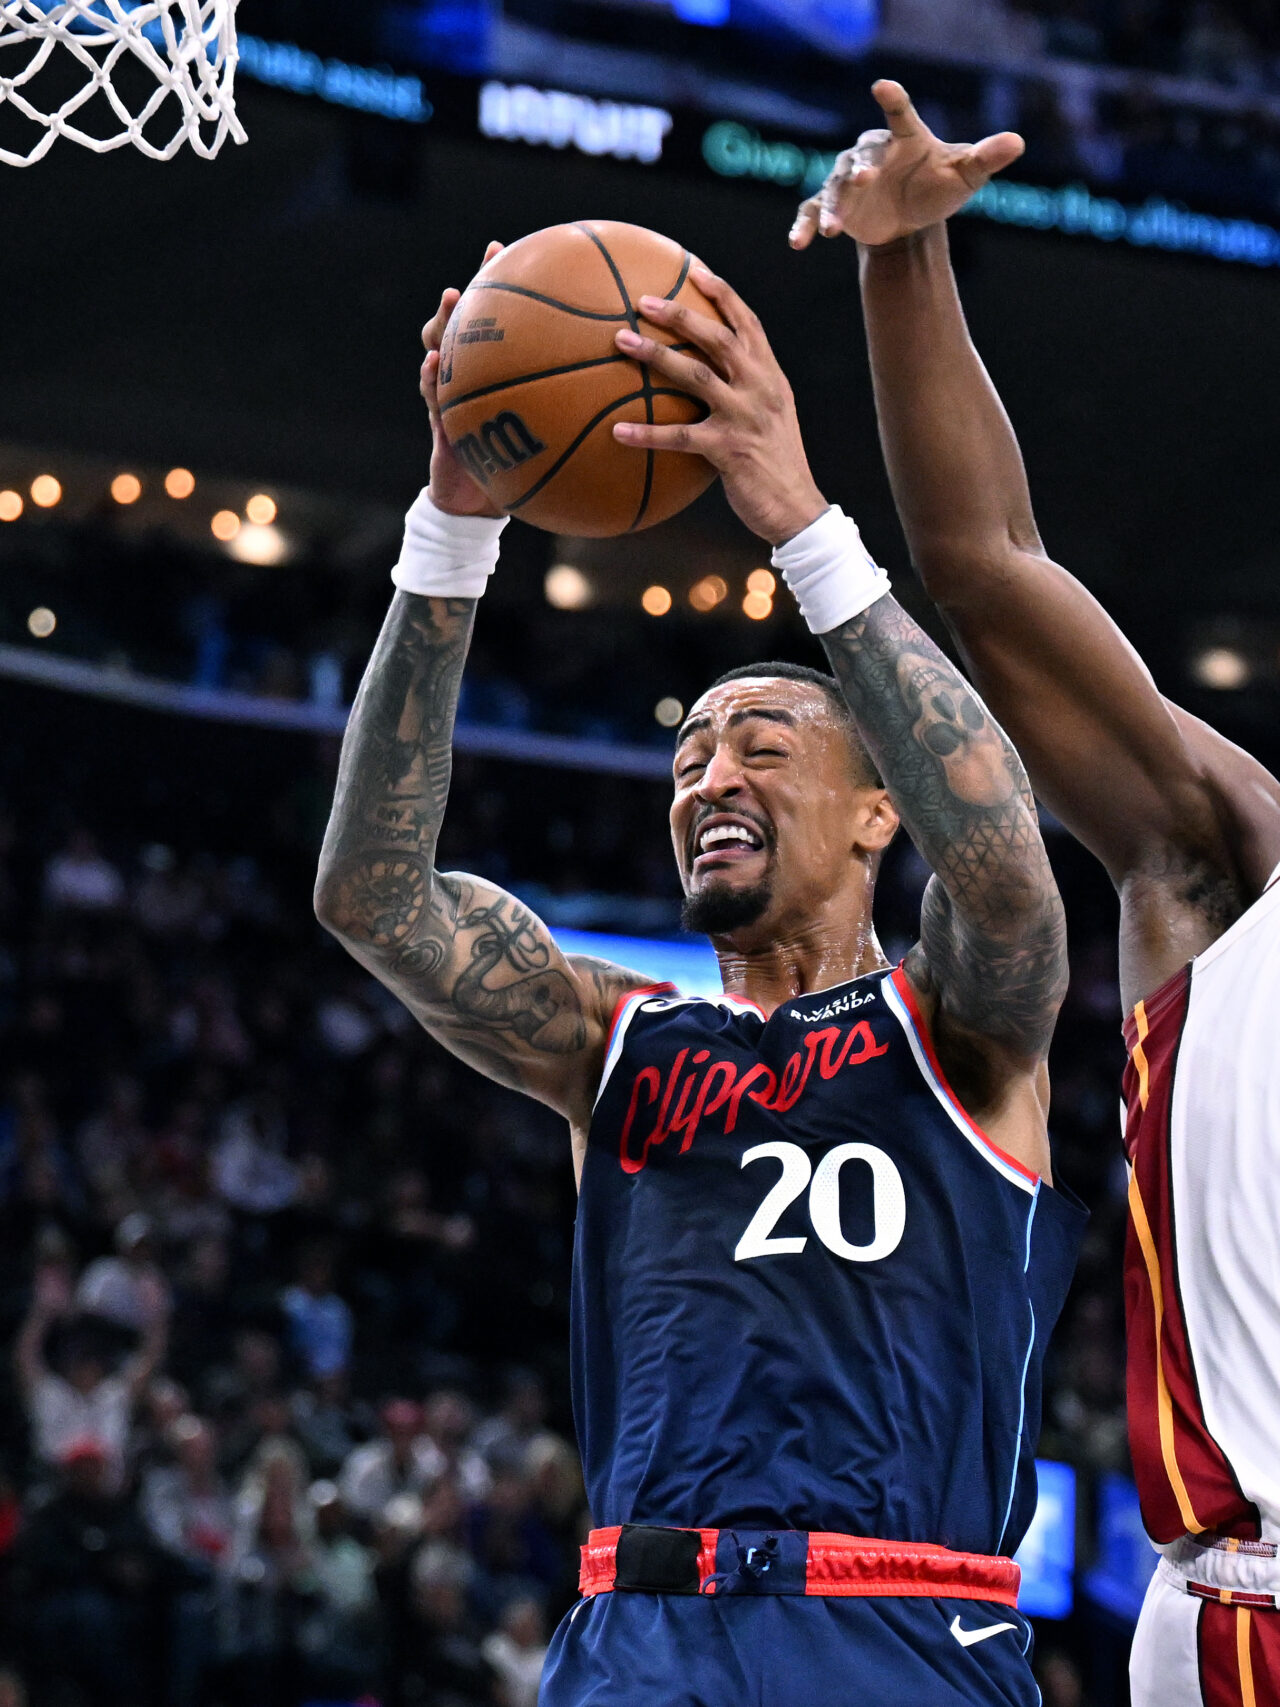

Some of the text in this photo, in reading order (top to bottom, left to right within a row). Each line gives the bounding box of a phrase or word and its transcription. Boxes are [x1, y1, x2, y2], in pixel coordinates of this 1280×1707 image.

[790, 992, 876, 1022] RWANDA
[812, 990, 859, 1016] VISIT
[619, 1019, 889, 1175] Clippers
[734, 1140, 907, 1262] 20
